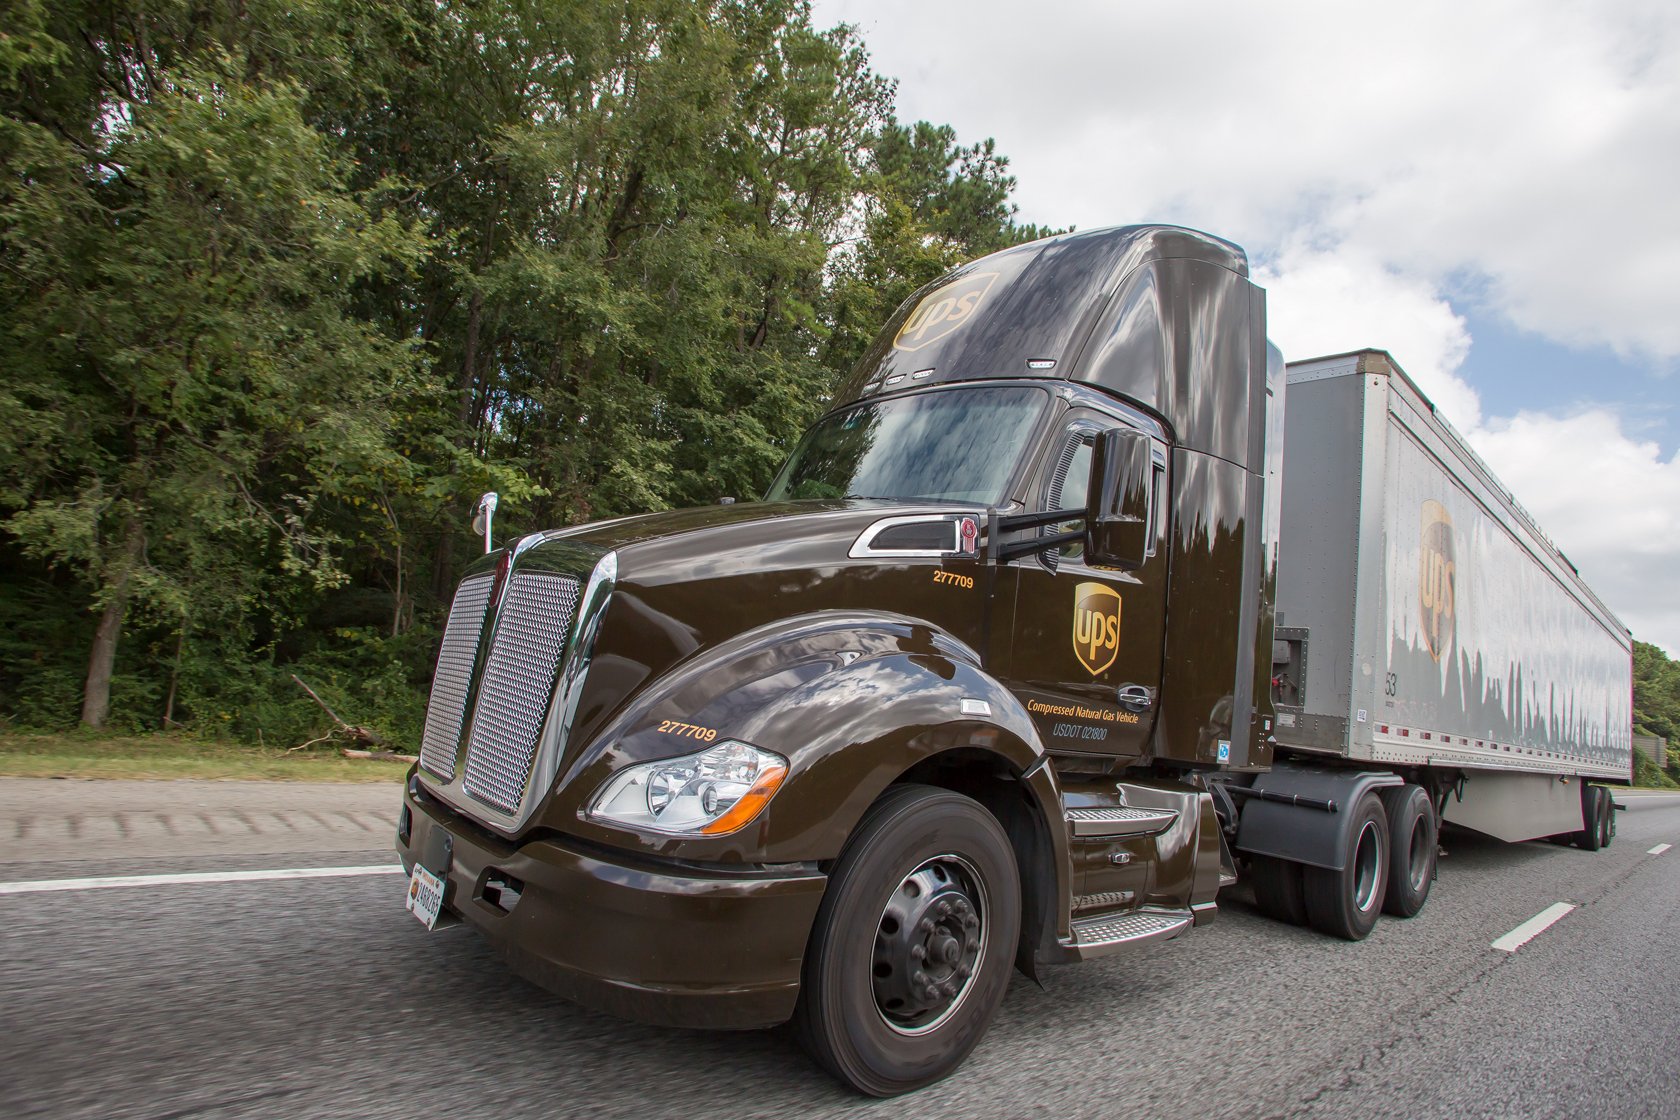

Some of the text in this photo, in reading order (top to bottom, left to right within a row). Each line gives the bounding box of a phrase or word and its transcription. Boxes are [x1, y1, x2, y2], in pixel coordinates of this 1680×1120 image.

[902, 290, 981, 341] ups
[933, 570, 974, 589] 277709
[1423, 544, 1455, 637] ups
[1077, 607, 1118, 660] ups
[1027, 699, 1139, 724] Compressed Natural Gas Vehicle
[657, 720, 717, 742] 277709
[1053, 724, 1107, 740] USDOT 021800
